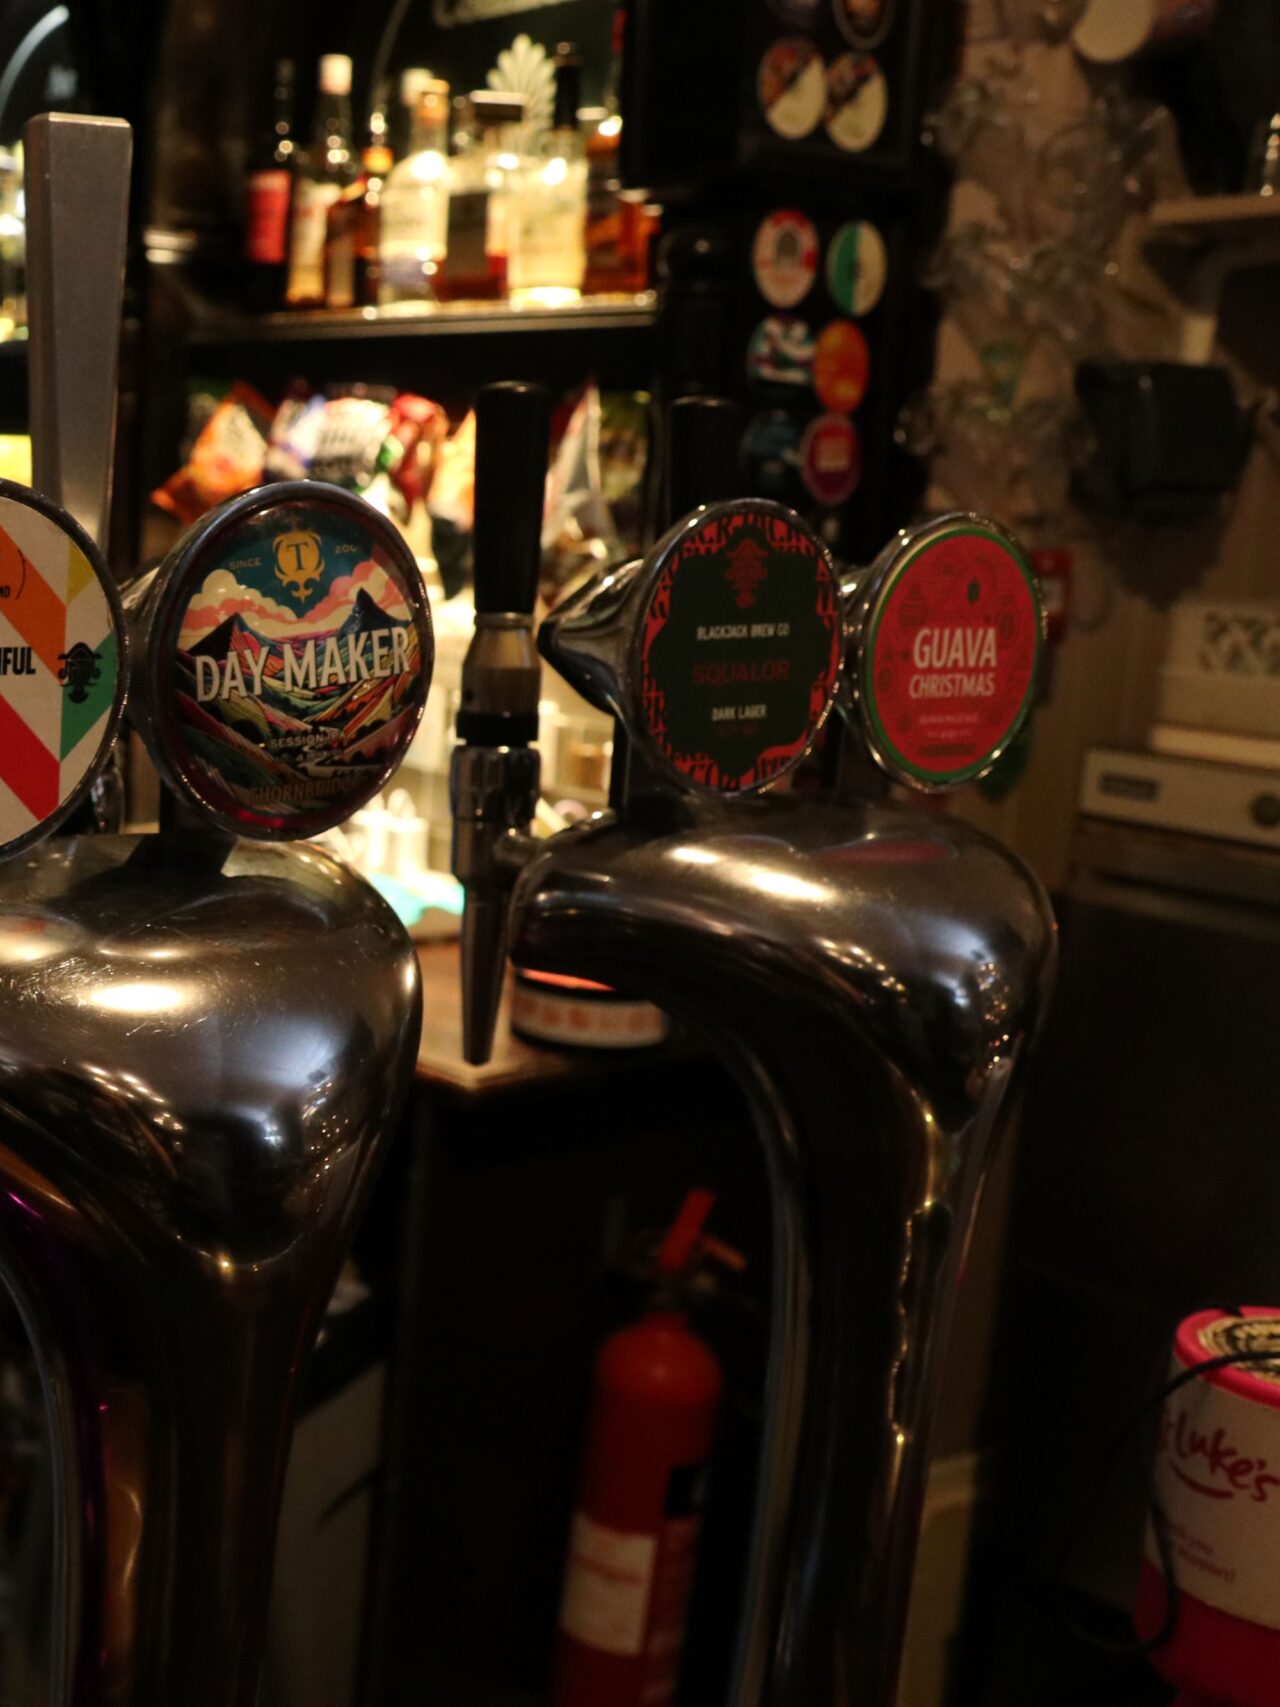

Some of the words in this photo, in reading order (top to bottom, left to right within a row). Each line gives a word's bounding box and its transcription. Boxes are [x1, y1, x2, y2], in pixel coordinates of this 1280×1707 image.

[229, 557, 262, 570] SINCE
[335, 544, 360, 555] 200
[696, 625, 749, 641] BLACKJACK
[750, 623, 776, 638] BREW
[776, 622, 790, 637] CO
[912, 627, 997, 669] GUAVA
[195, 647, 270, 703] DAY
[282, 626, 412, 693] MAKER
[692, 659, 791, 687] SQUALOR
[908, 672, 996, 700] CHRISTMAS
[711, 706, 736, 722] DARK
[738, 703, 767, 720] LAGER
[269, 733, 324, 749] SESSION
[249, 776, 360, 803] THORNBRID
